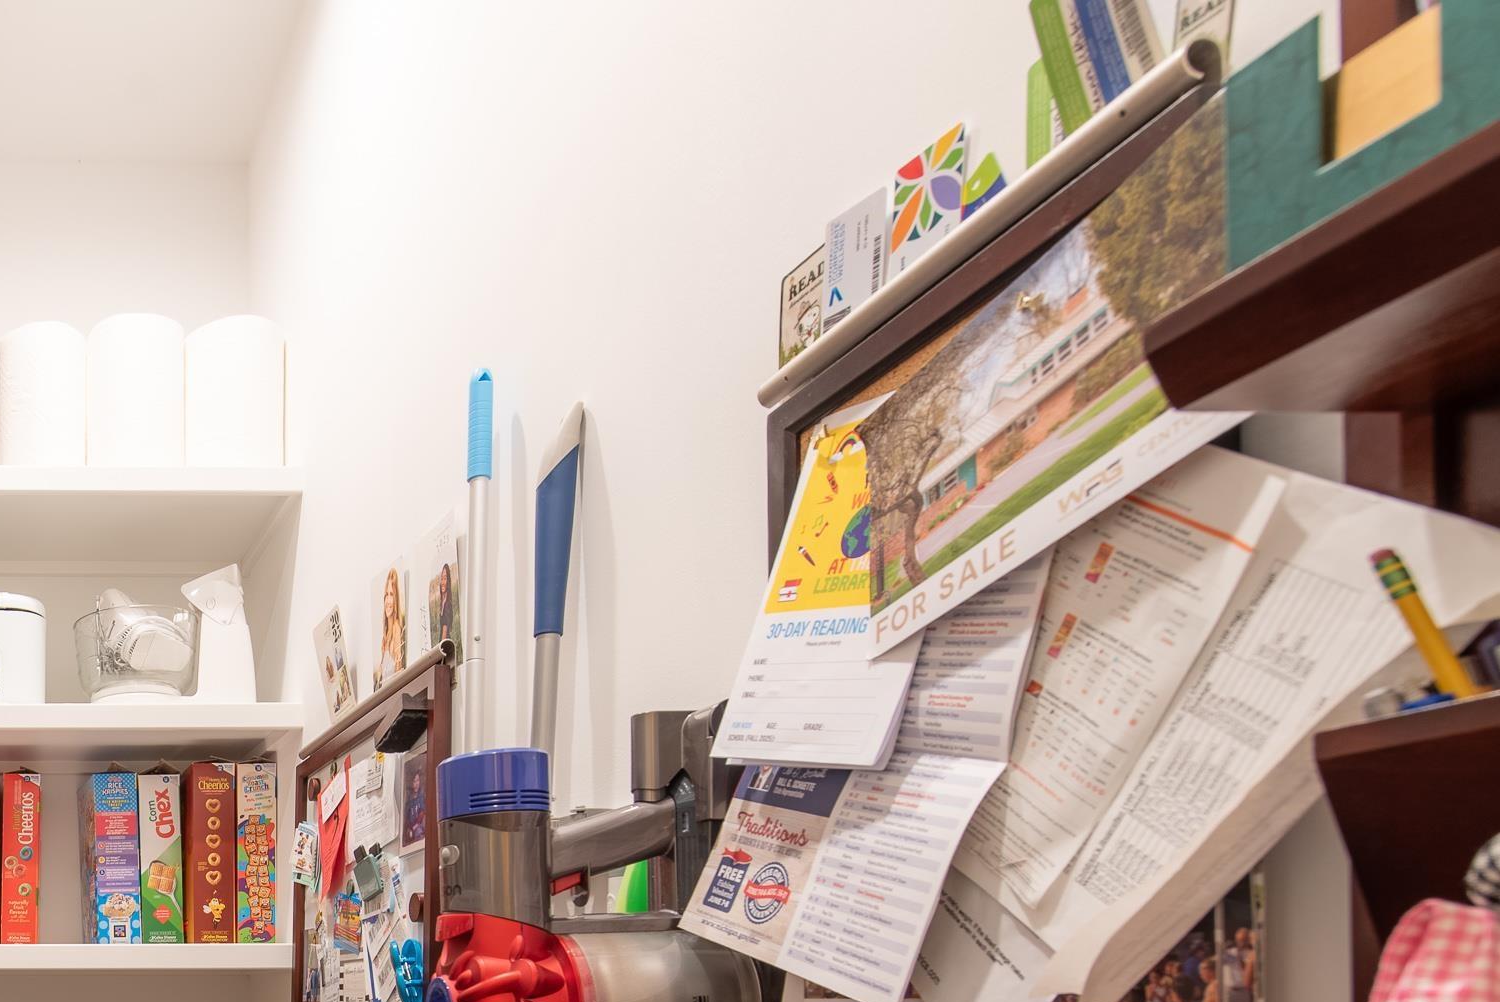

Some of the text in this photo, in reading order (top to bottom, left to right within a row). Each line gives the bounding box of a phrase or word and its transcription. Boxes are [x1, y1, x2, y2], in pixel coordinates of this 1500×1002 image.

[828, 556, 871, 575] AT TH
[813, 572, 871, 594] LIBRAR
[875, 590, 928, 644] FOR
[939, 528, 1018, 602] SALE
[766, 617, 871, 640] 30-DAY READING
[198, 781, 230, 790] Cheerios
[244, 783, 269, 793] Crunch
[17, 792, 34, 845] Cheerios
[148, 800, 157, 822] corn
[155, 787, 175, 839] Chex
[737, 811, 809, 847] Traditions
[717, 865, 745, 883] FREE
